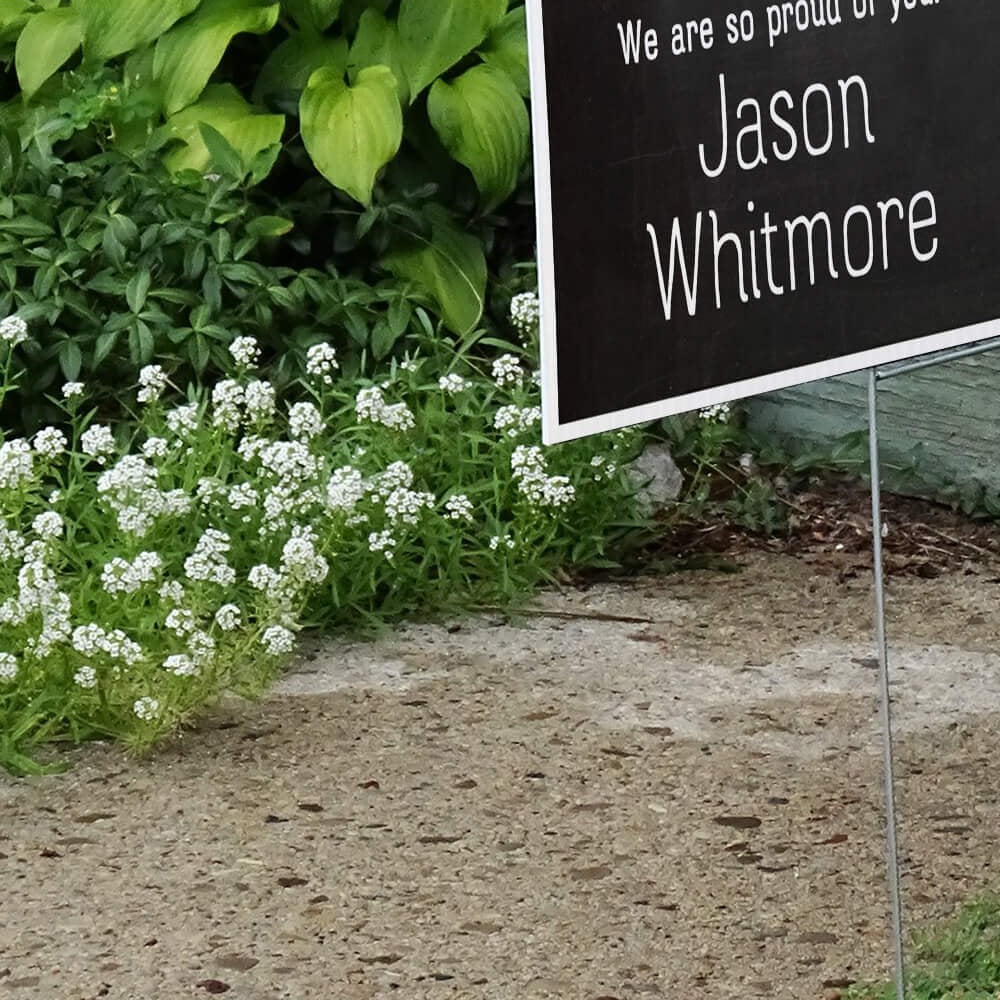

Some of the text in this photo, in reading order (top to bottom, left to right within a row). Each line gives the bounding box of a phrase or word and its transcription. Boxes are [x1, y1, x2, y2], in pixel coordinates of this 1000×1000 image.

[617, 19, 659, 65] We
[671, 13, 714, 56] are
[726, 10, 755, 44] so
[698, 73, 876, 178] Jason
[646, 190, 939, 321] Whitmore
